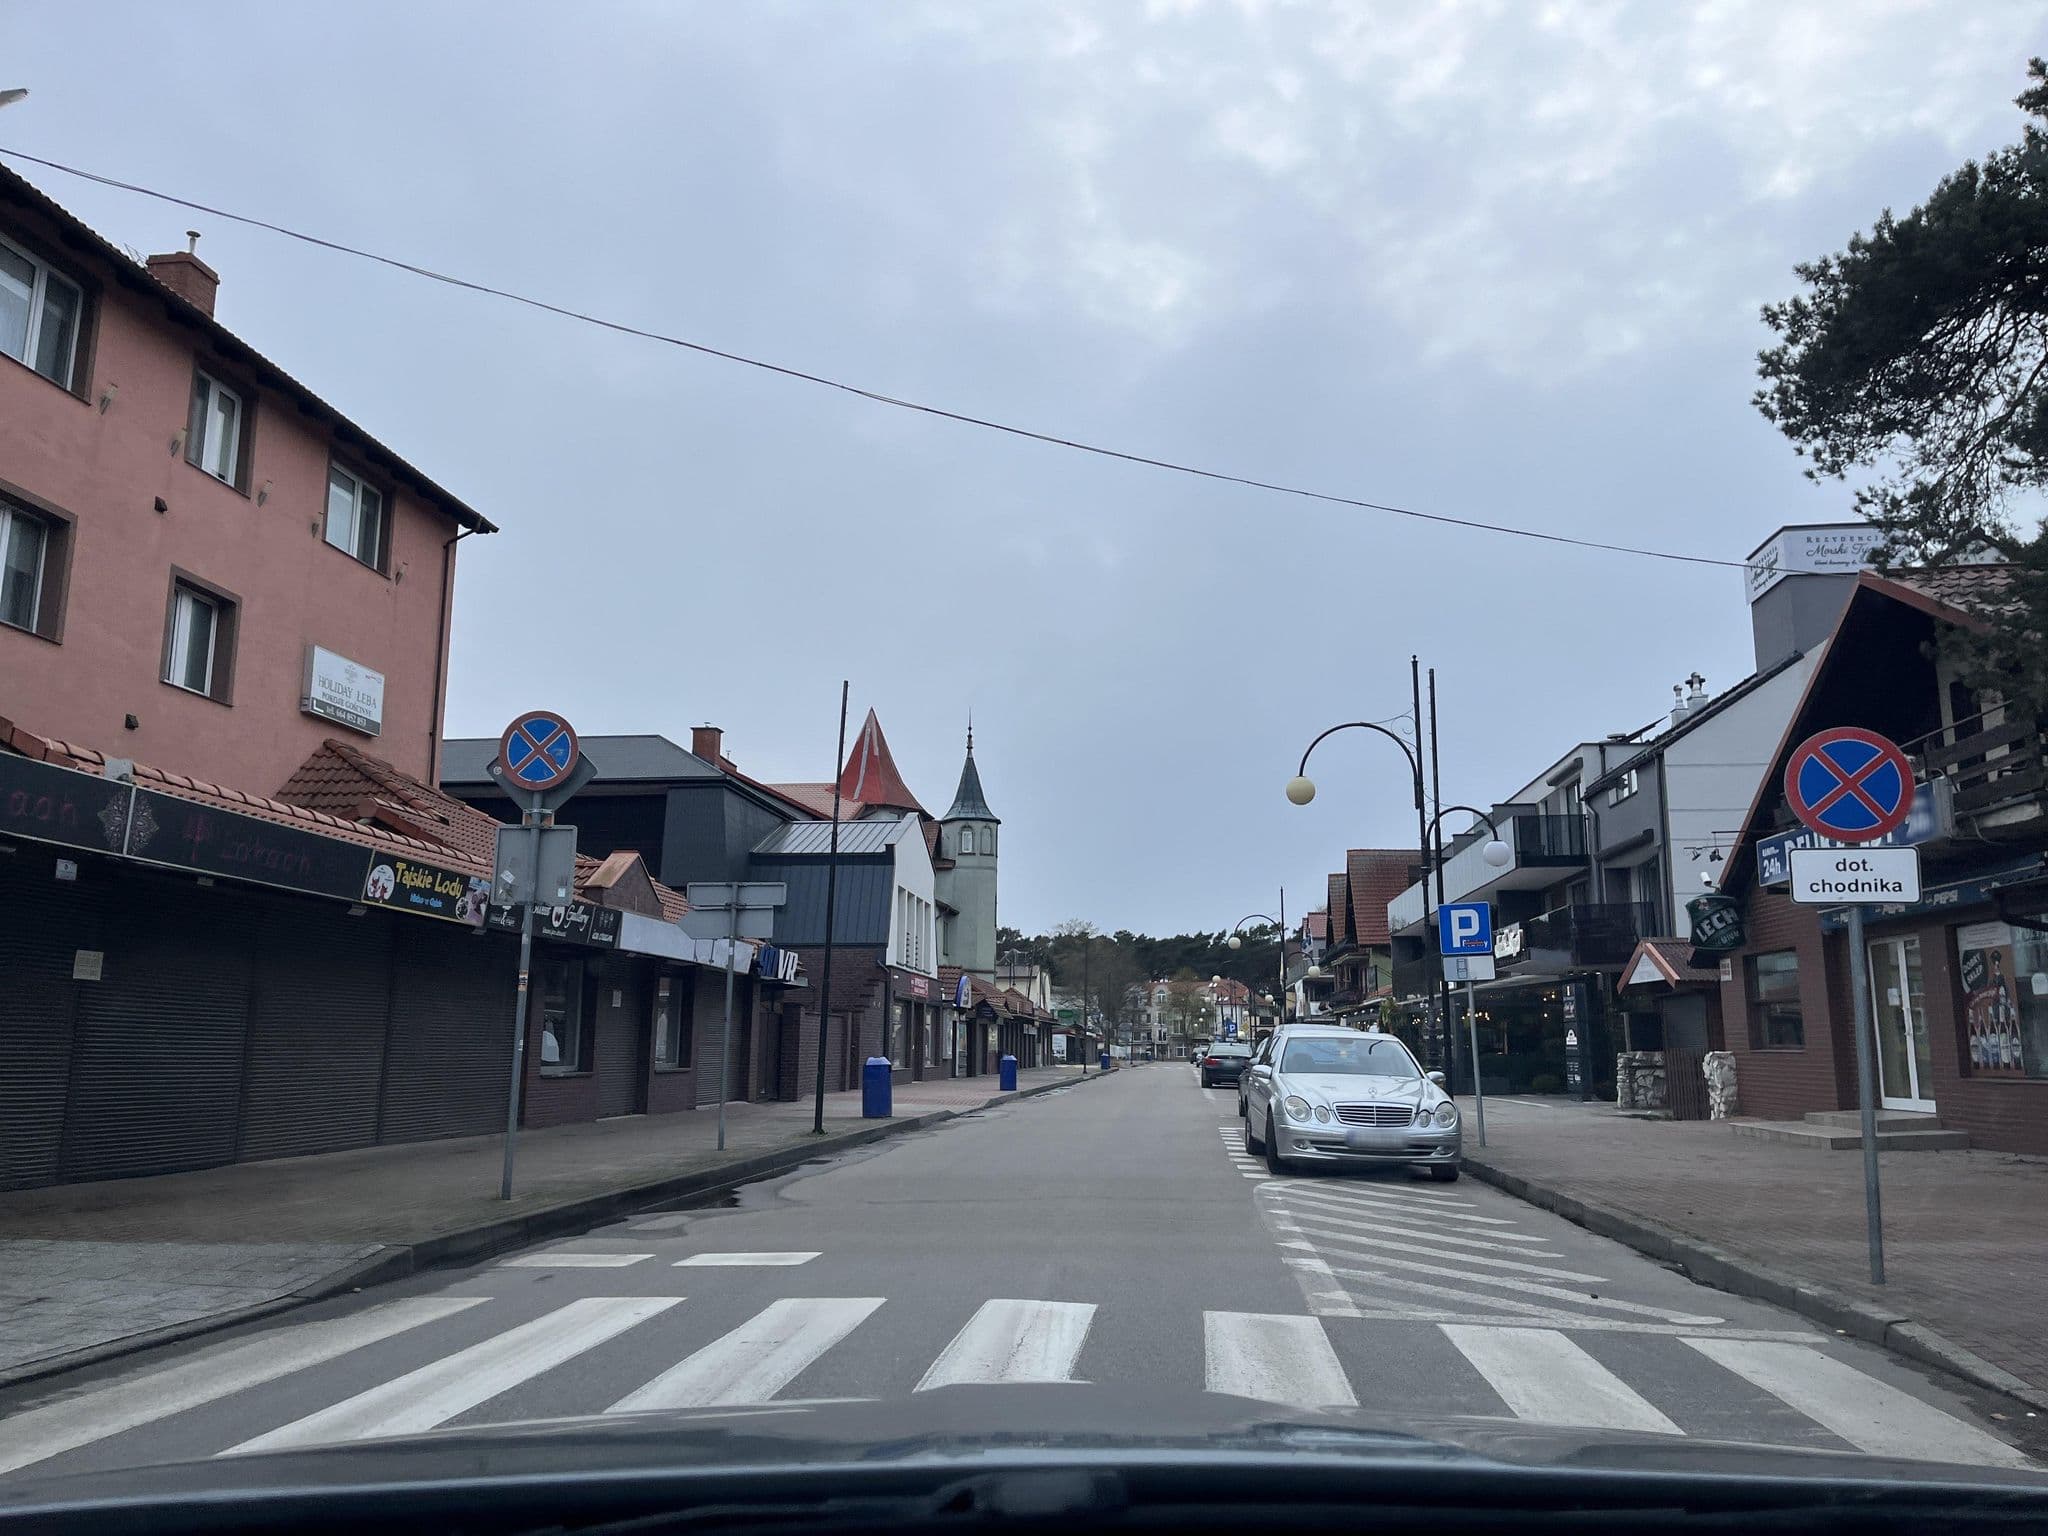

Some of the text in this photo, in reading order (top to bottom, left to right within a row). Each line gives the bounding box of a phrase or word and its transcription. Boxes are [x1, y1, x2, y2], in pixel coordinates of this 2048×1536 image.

[318, 675, 354, 698] HOLIDAY
[1763, 856, 1781, 878] 24h
[1836, 858, 1873, 872] dot.
[395, 861, 433, 889] Tajskie
[434, 872, 464, 899] Lody
[1809, 878, 1903, 893] chodnika
[1450, 909, 1480, 948] P
[1696, 907, 1739, 943] LECH
[1229, 1024, 1236, 1032] P
